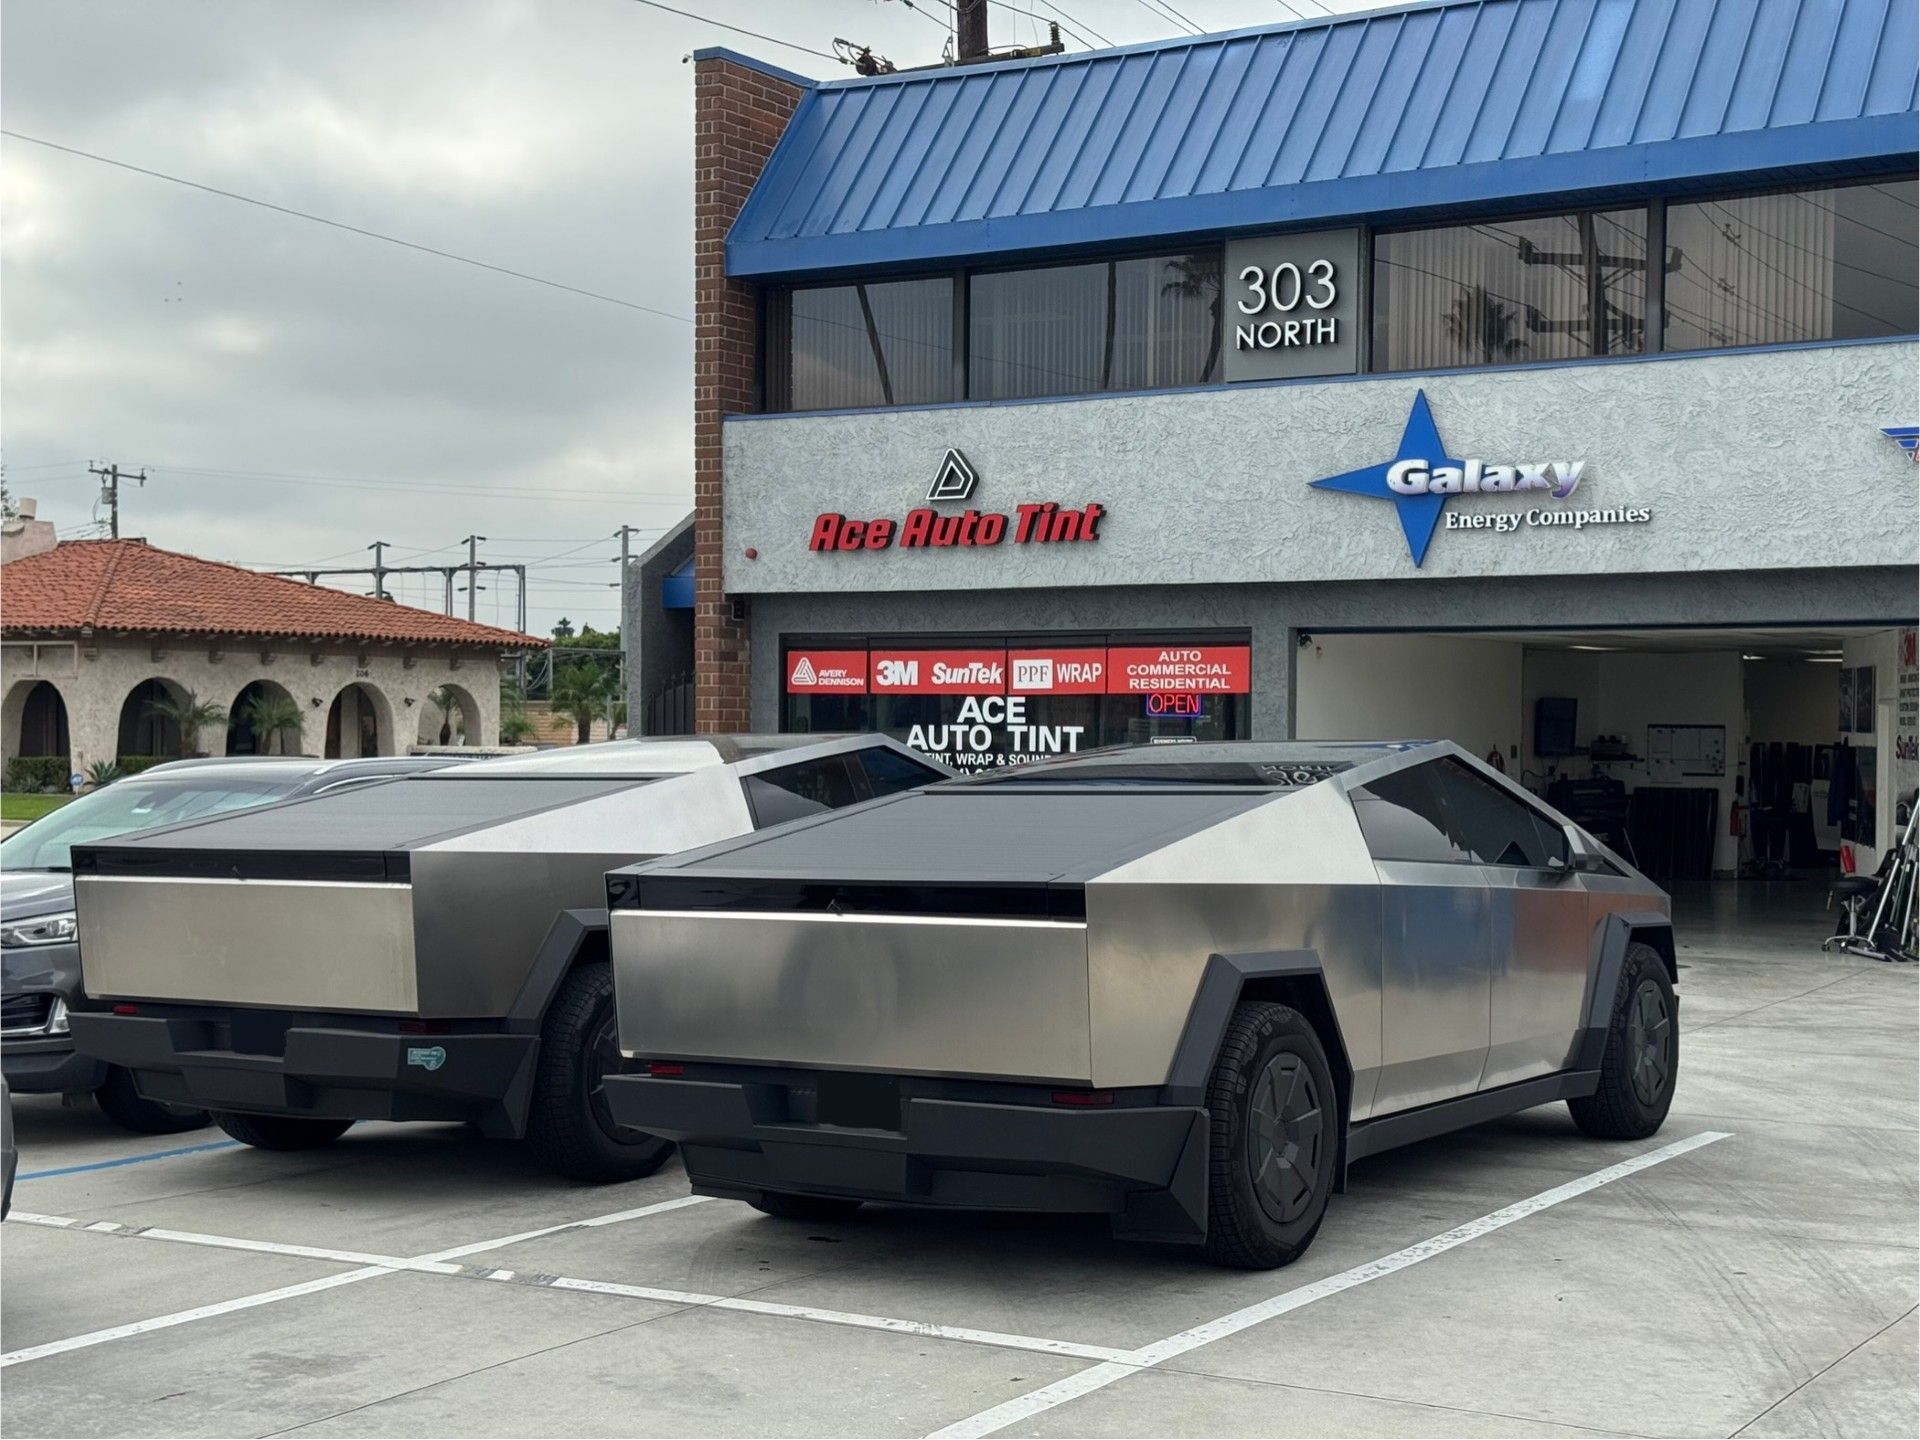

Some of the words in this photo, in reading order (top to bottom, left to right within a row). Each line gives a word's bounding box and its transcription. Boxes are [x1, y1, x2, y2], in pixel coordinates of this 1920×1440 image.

[1237, 259, 1336, 315] 303
[1236, 317, 1335, 350] NORTH
[1386, 458, 1586, 499] Galaxy
[808, 512, 897, 554] Ace
[899, 508, 1008, 549] Auto
[1015, 502, 1106, 544] Tint
[1445, 511, 1522, 532] Energy
[1525, 505, 1651, 530] Companies
[1158, 650, 1202, 662] AUTO
[818, 669, 848, 677] AVERY
[818, 677, 865, 686] DENNISON
[875, 660, 919, 686] 3M
[931, 661, 1004, 685] SunTek
[1017, 664, 1050, 682] PPF
[1056, 662, 1102, 684] WRAP
[1126, 663, 1233, 676] COMMERCIAL
[1129, 677, 1231, 690] RESIDENTIAL
[956, 695, 1027, 725] ACE
[1149, 693, 1200, 714] OPEN
[905, 723, 993, 752] AUTO
[1006, 724, 1085, 754] TINT
[956, 752, 994, 766] WRAP
[996, 753, 1006, 766] &
